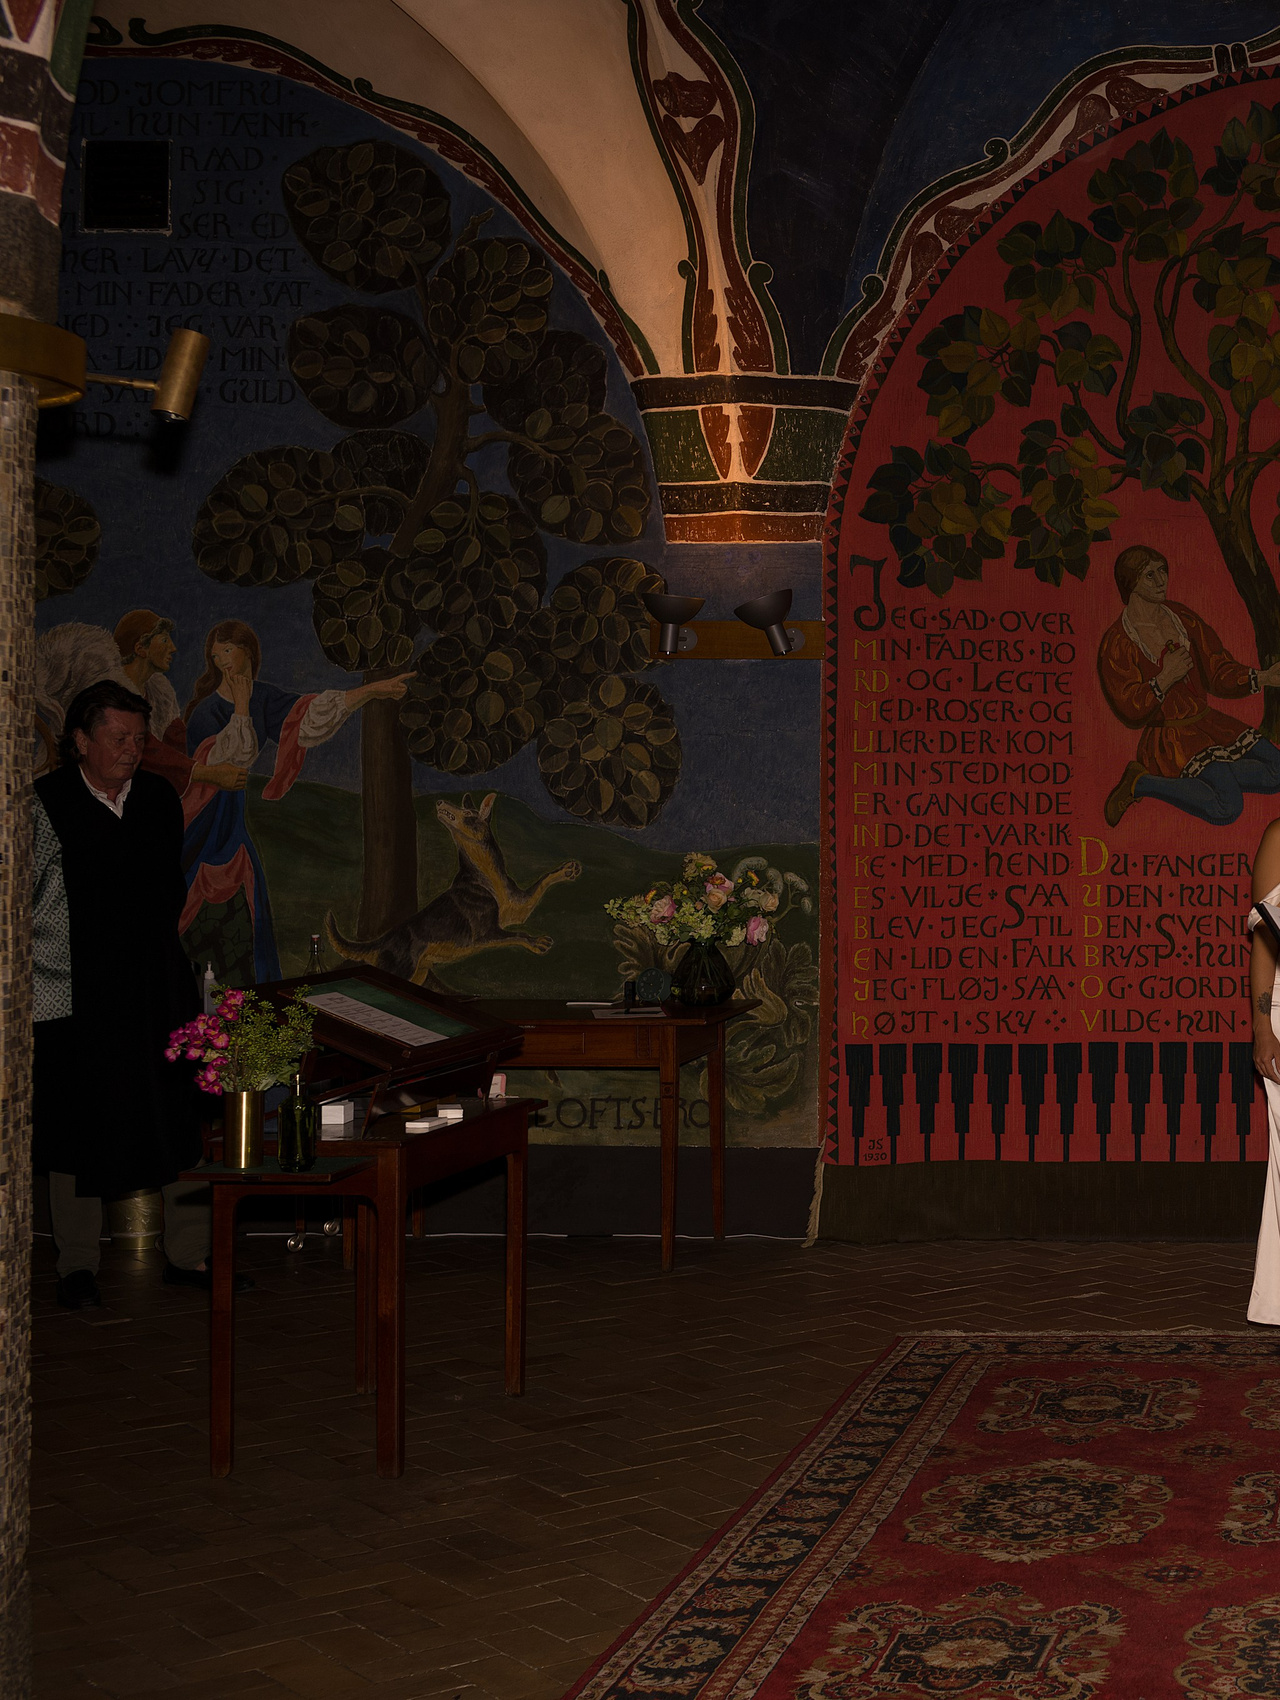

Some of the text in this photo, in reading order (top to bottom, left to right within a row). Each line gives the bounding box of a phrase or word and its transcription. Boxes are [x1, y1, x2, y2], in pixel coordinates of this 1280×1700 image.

[135, 80, 284, 107] JOMFRU
[180, 145, 264, 172] RAAD
[192, 178, 245, 206] SIG
[231, 246, 297, 274] DET
[76, 281, 134, 306] MIN
[147, 280, 245, 308] FADER
[219, 315, 279, 341] VAR
[219, 346, 284, 372] MIN
[219, 379, 297, 405] GULD
[850, 554, 1076, 635] JEG SAD OVER
[853, 633, 1076, 664] MIN FADERS BO
[853, 662, 1074, 695] RD OG LEGTE
[853, 698, 1073, 724] MED ROSER OG
[853, 729, 1073, 755] LILIER DER KOM
[853, 761, 916, 786] MIN
[853, 791, 1073, 816] ER GANGENDE
[853, 823, 904, 847] IND
[914, 823, 974, 847] DET
[982, 823, 1042, 846] VAR
[855, 854, 886, 879] KE
[901, 853, 968, 877] MED
[1078, 835, 1129, 877] DU
[853, 886, 886, 910] ES
[900, 883, 983, 908] VILJE
[1082, 884, 1163, 908] UDEN
[853, 915, 1073, 939] BLEV JEG TIL
[1083, 914, 1142, 938] DEN
[853, 938, 1078, 971] EN LIDEN FALK
[853, 974, 1067, 1001] JEG FLØJ SAA
[1081, 975, 1126, 999] OG
[974, 1010, 1037, 1037] SKY
[1080, 1008, 1162, 1034] VILDE
